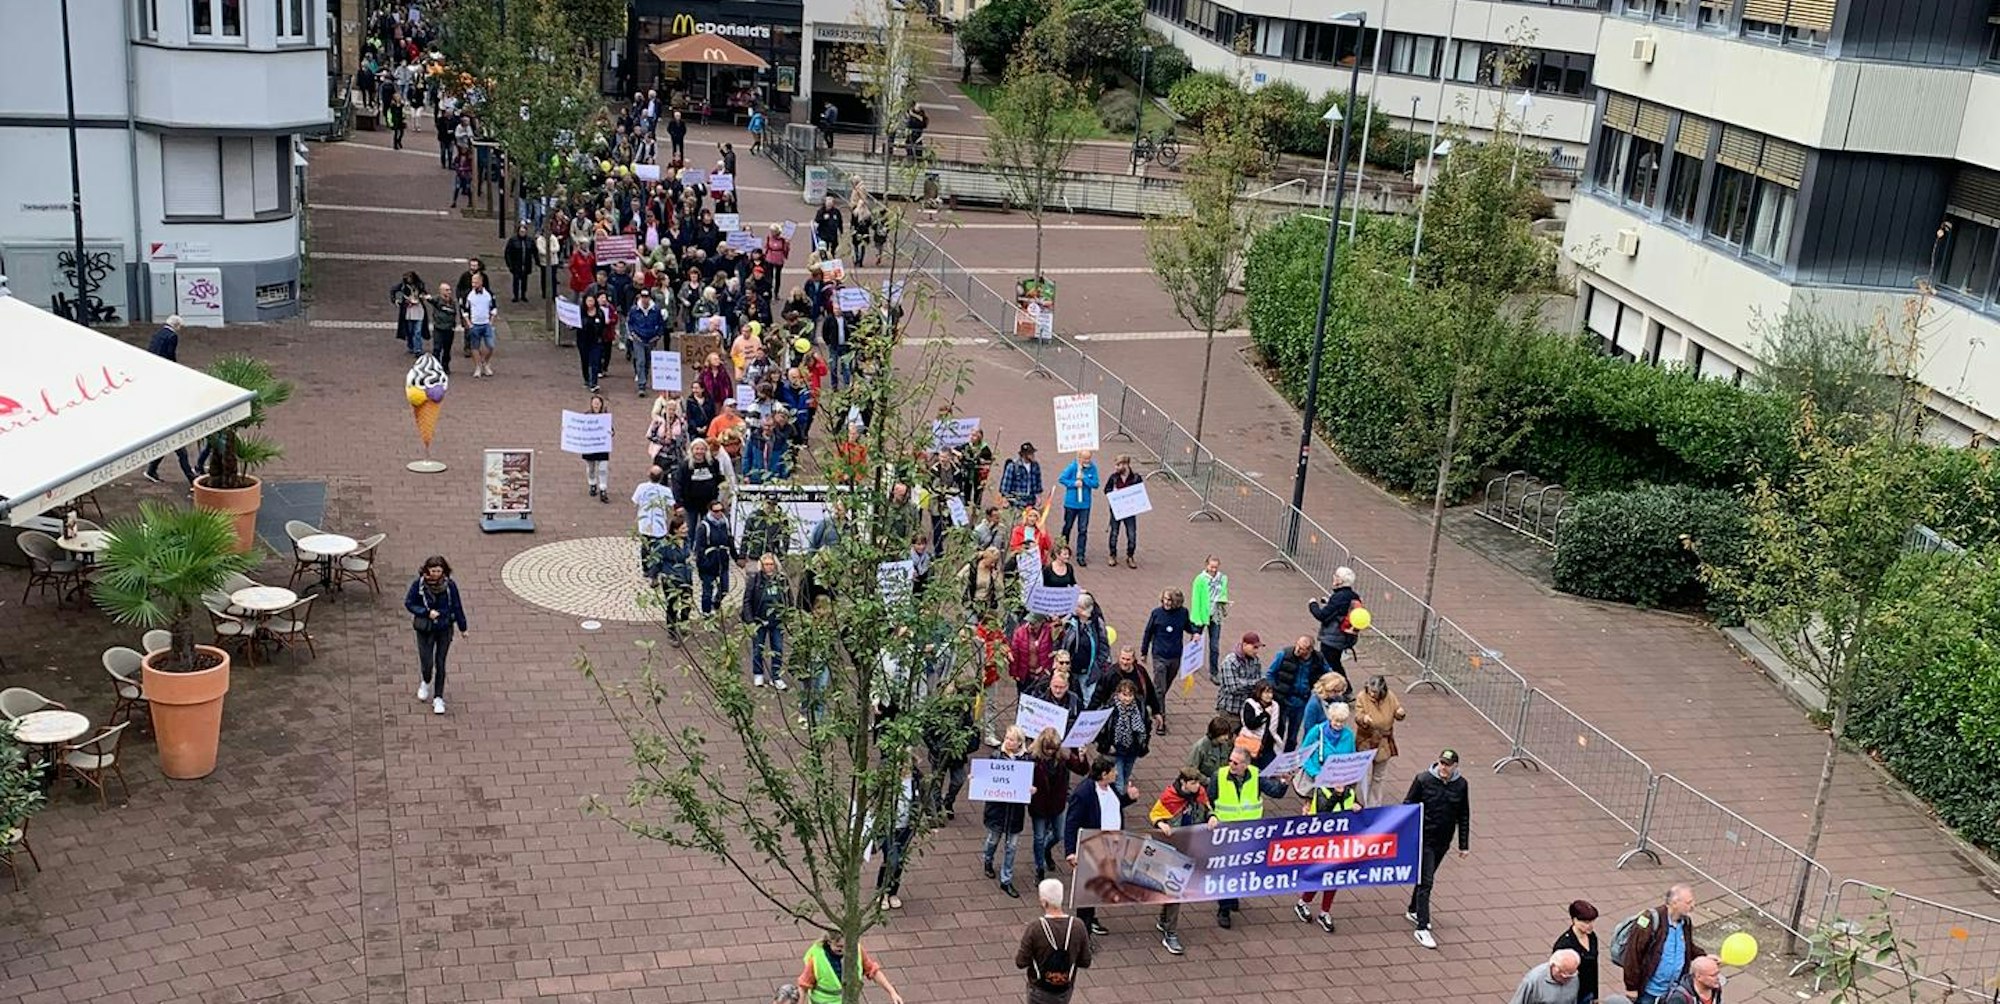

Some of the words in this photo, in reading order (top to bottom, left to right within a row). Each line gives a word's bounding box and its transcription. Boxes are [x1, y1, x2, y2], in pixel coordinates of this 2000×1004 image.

[672, 14, 770, 38] McDonald's
[990, 762, 1015, 771] Lasst
[993, 776, 1010, 784] uns
[984, 788, 1017, 798] reden!
[1211, 823, 1278, 846] Unser
[1282, 817, 1349, 837] Leben
[1206, 849, 1266, 869] muss
[1271, 839, 1393, 862] bezahlbar
[1204, 870, 1298, 895] bleiben!
[1322, 866, 1412, 886] REK-NRW
